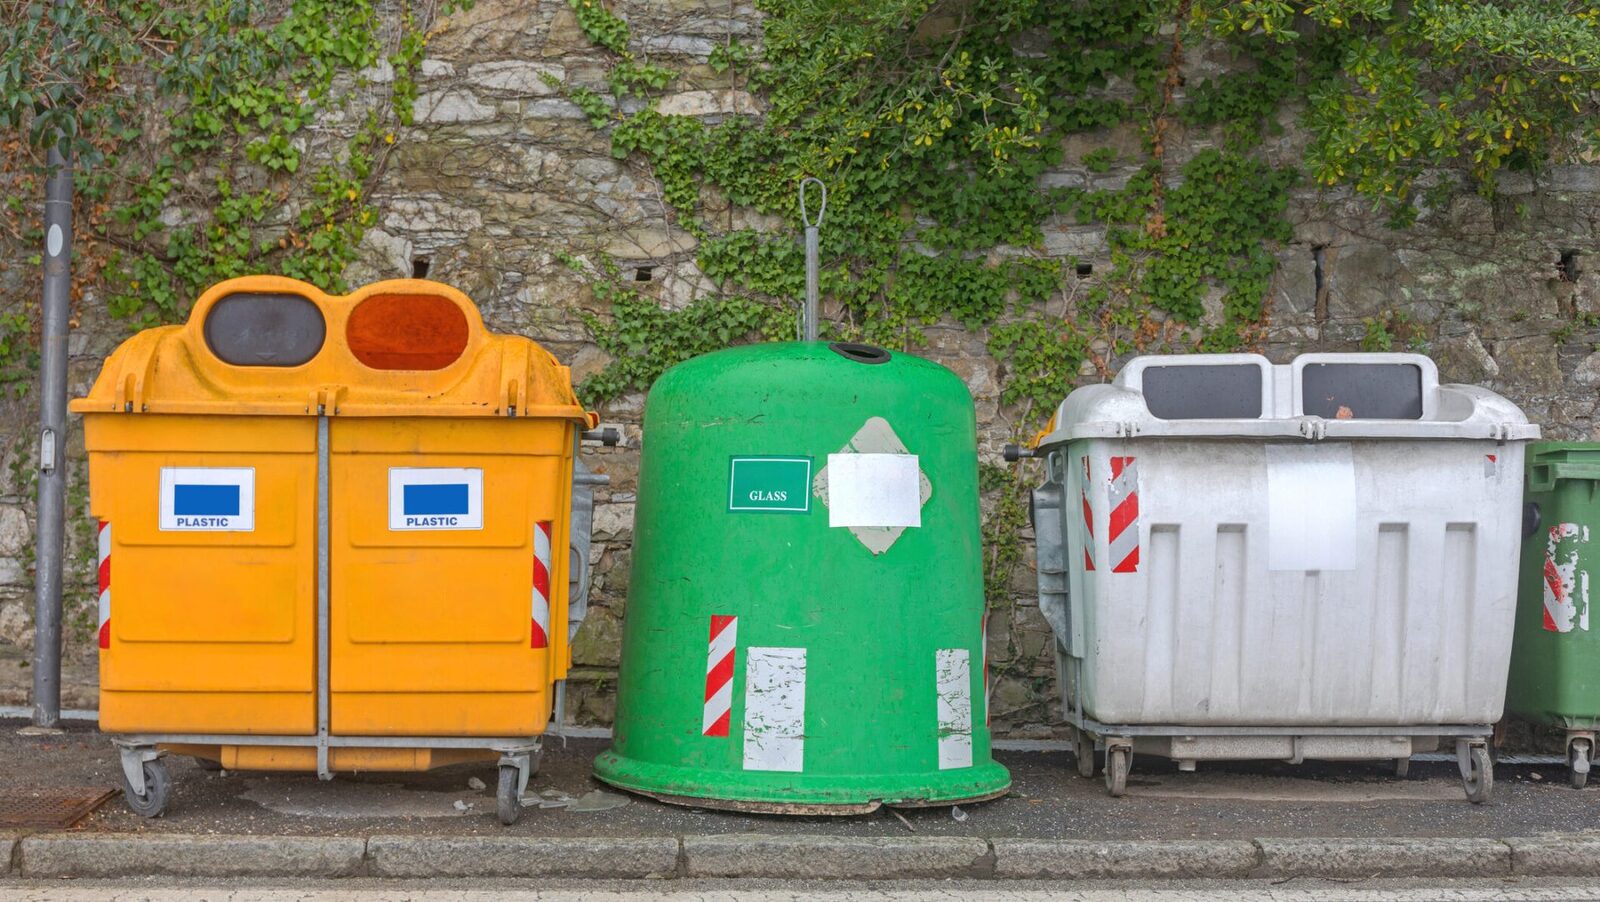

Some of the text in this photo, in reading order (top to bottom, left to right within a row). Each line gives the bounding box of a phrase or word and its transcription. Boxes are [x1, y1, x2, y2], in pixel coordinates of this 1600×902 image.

[749, 490, 787, 501] GLASS
[177, 518, 228, 527] PLASTIC
[406, 517, 457, 526] PLASTIC
